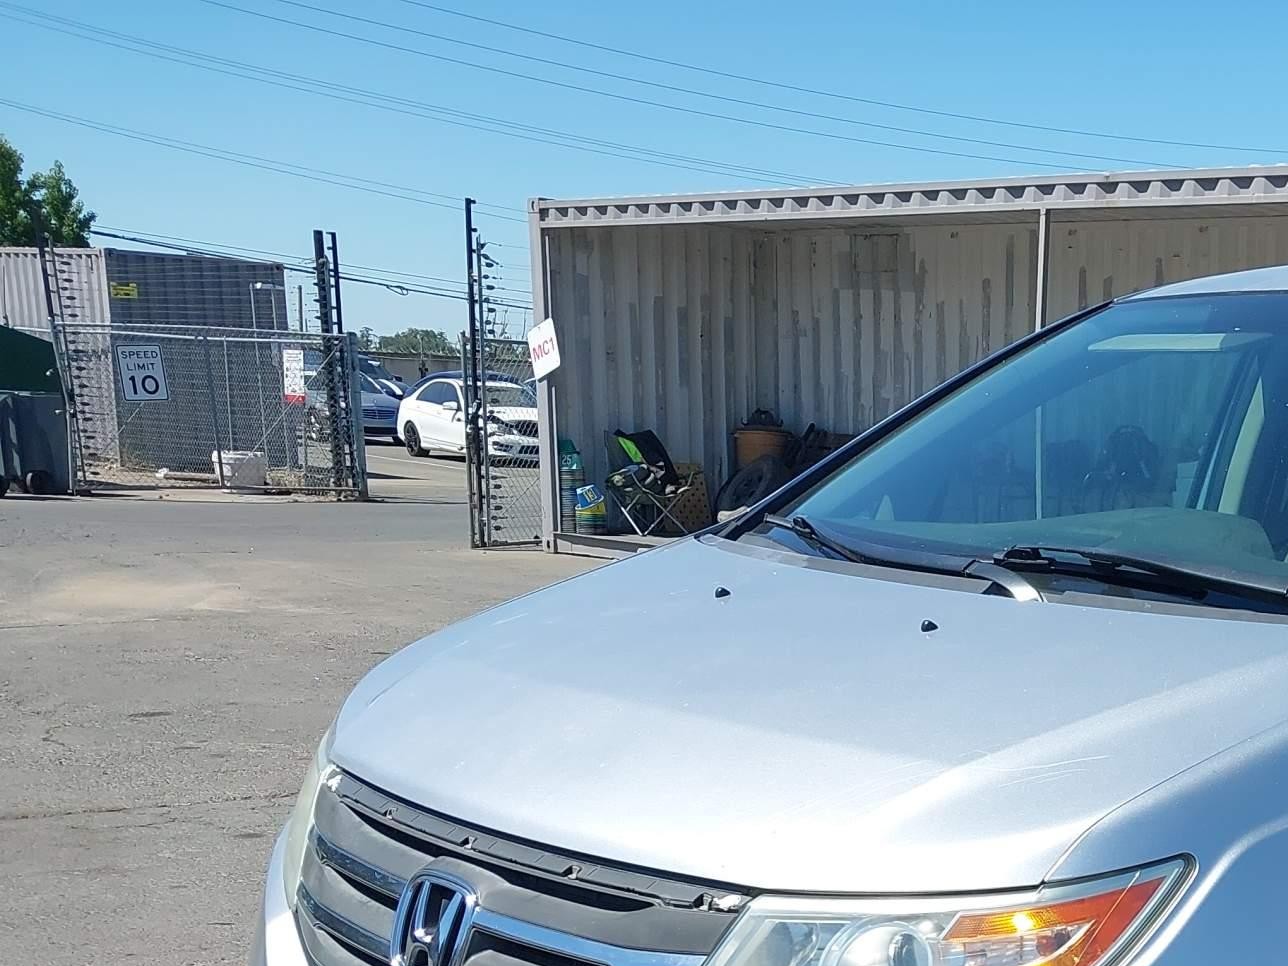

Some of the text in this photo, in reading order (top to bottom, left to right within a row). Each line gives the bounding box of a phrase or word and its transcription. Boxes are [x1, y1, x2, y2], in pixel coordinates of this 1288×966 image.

[121, 350, 158, 359] SPEED
[532, 336, 555, 363] MC1
[126, 362, 157, 371] LIMIT
[129, 375, 159, 395] 10
